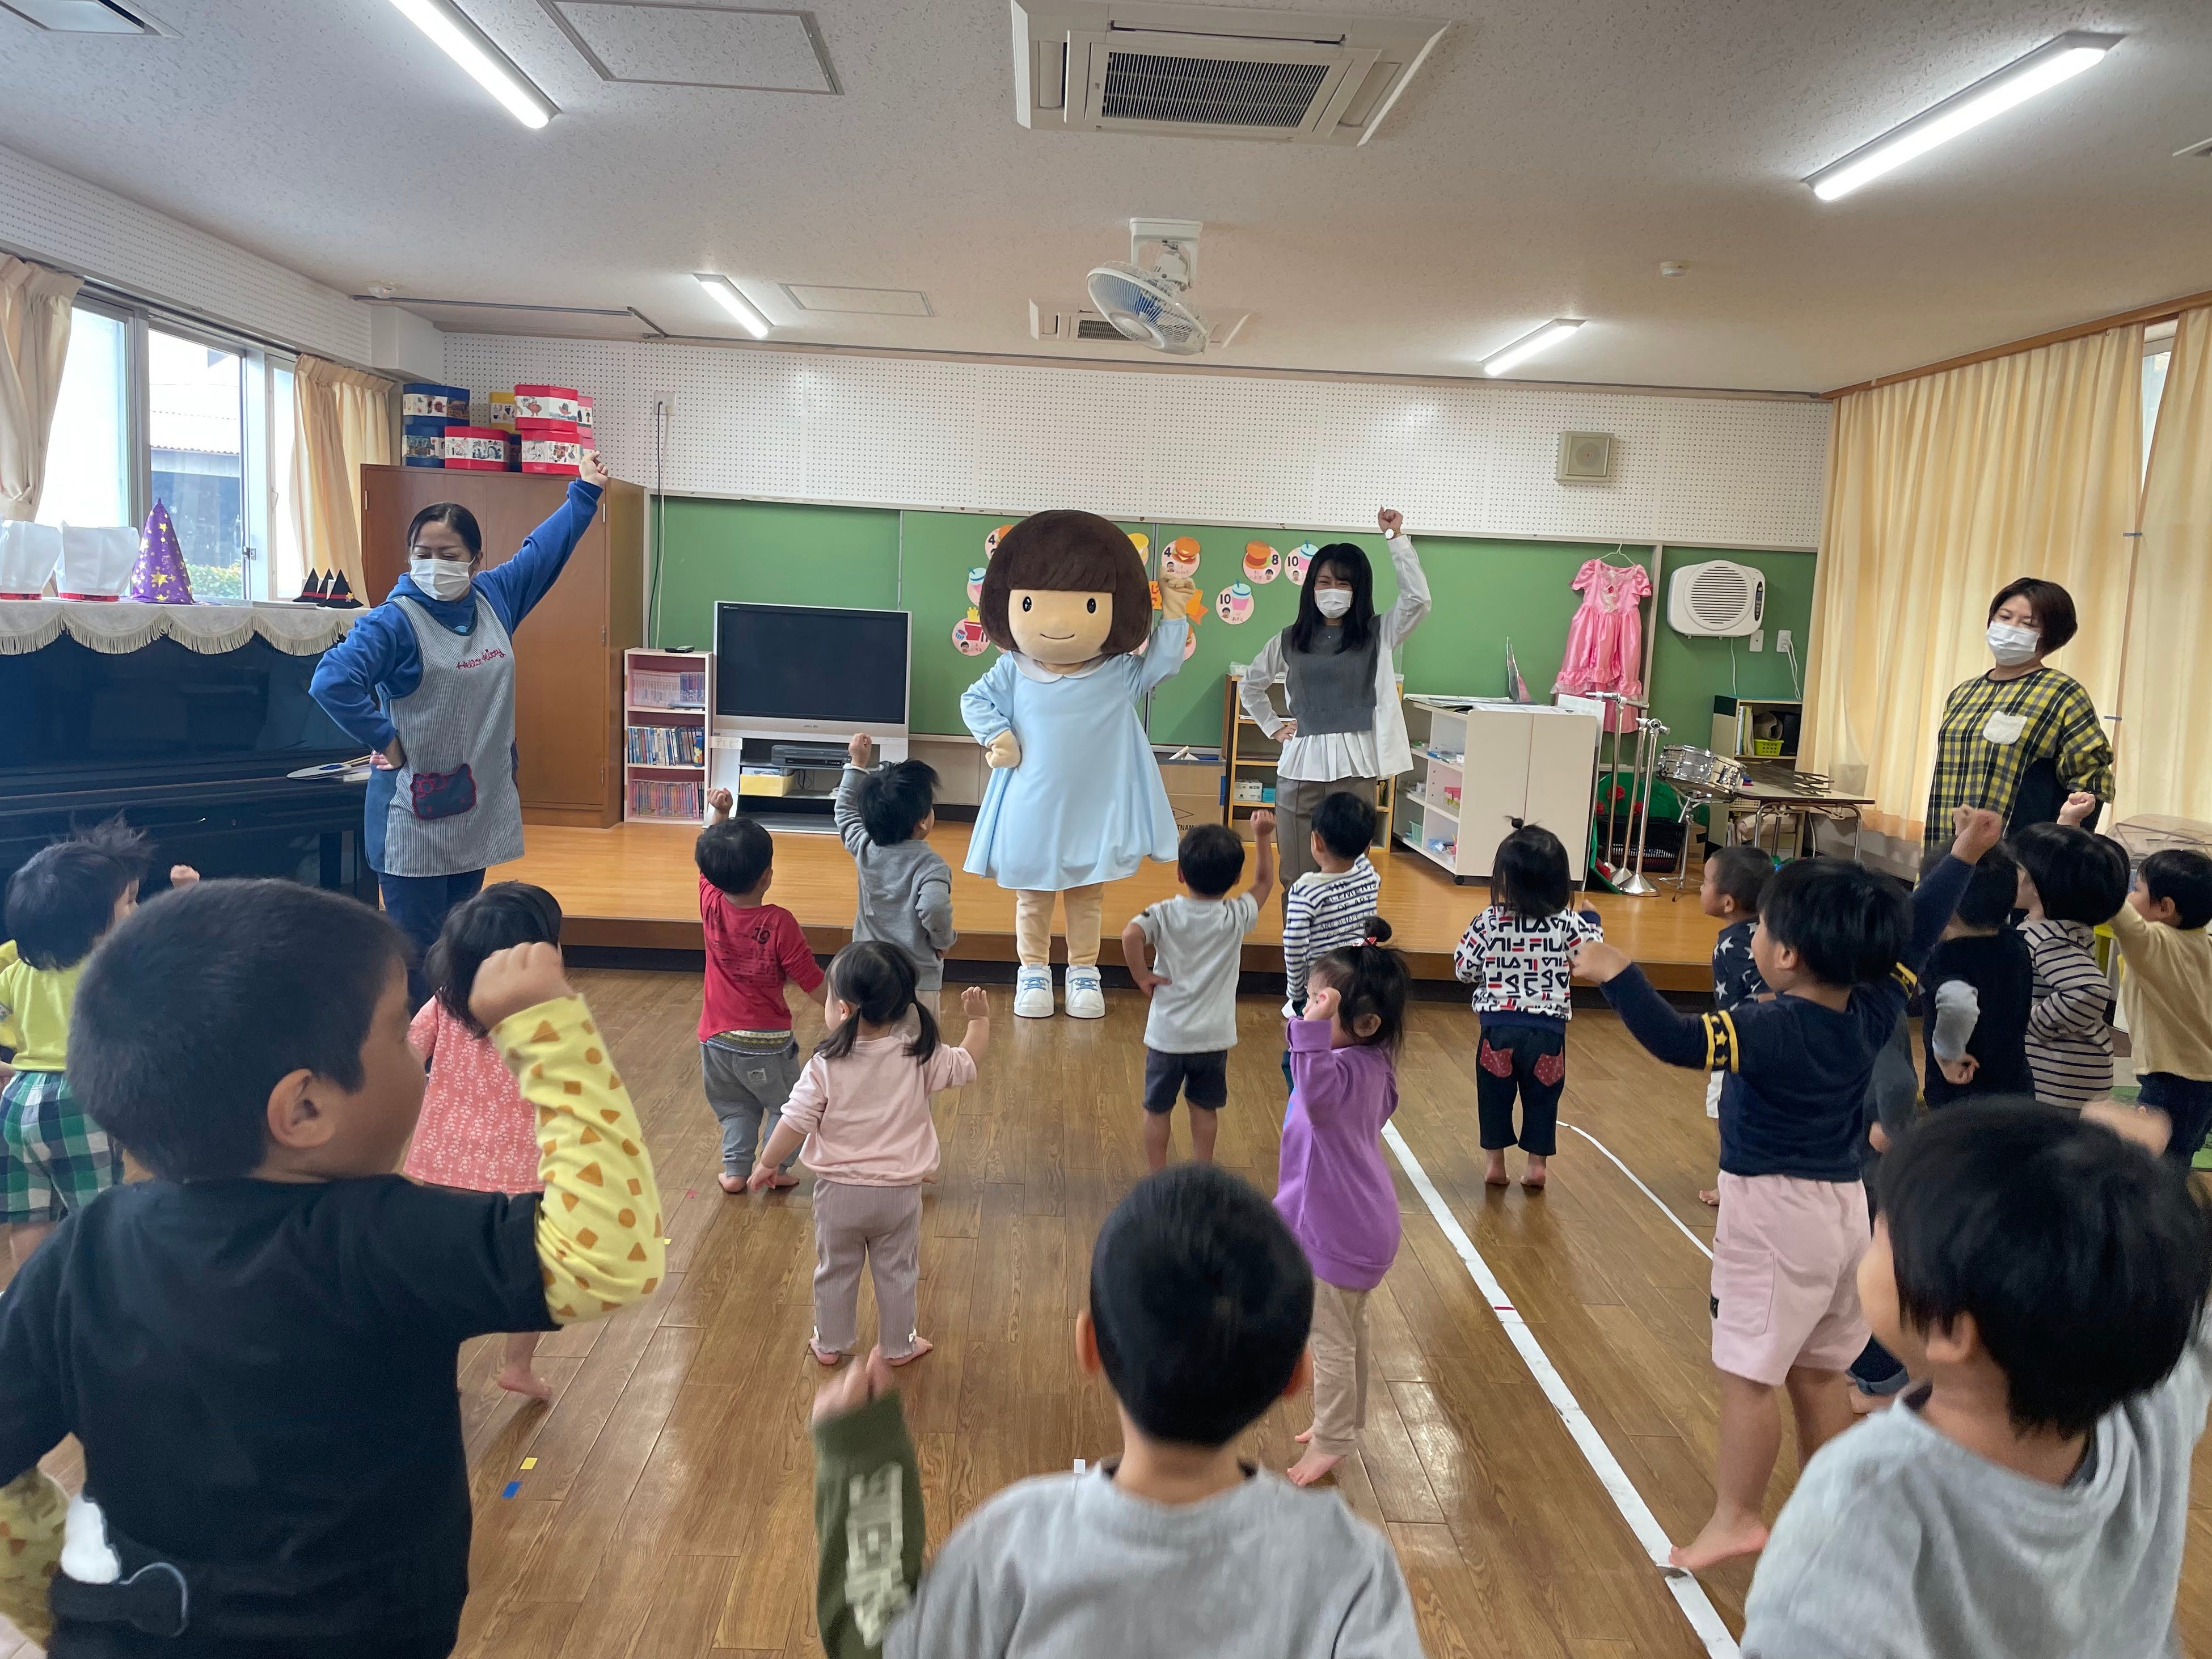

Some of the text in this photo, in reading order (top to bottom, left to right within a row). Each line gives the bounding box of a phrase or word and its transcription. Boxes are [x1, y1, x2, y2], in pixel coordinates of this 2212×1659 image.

[988, 534, 996, 545] 4
[1164, 547, 1172, 557] 4
[1272, 554, 1279, 565] 8
[1287, 556, 1299, 567] 10
[1220, 593, 1231, 605] 10
[1498, 916, 1551, 933] FILA
[1485, 956, 1521, 969] FILA
